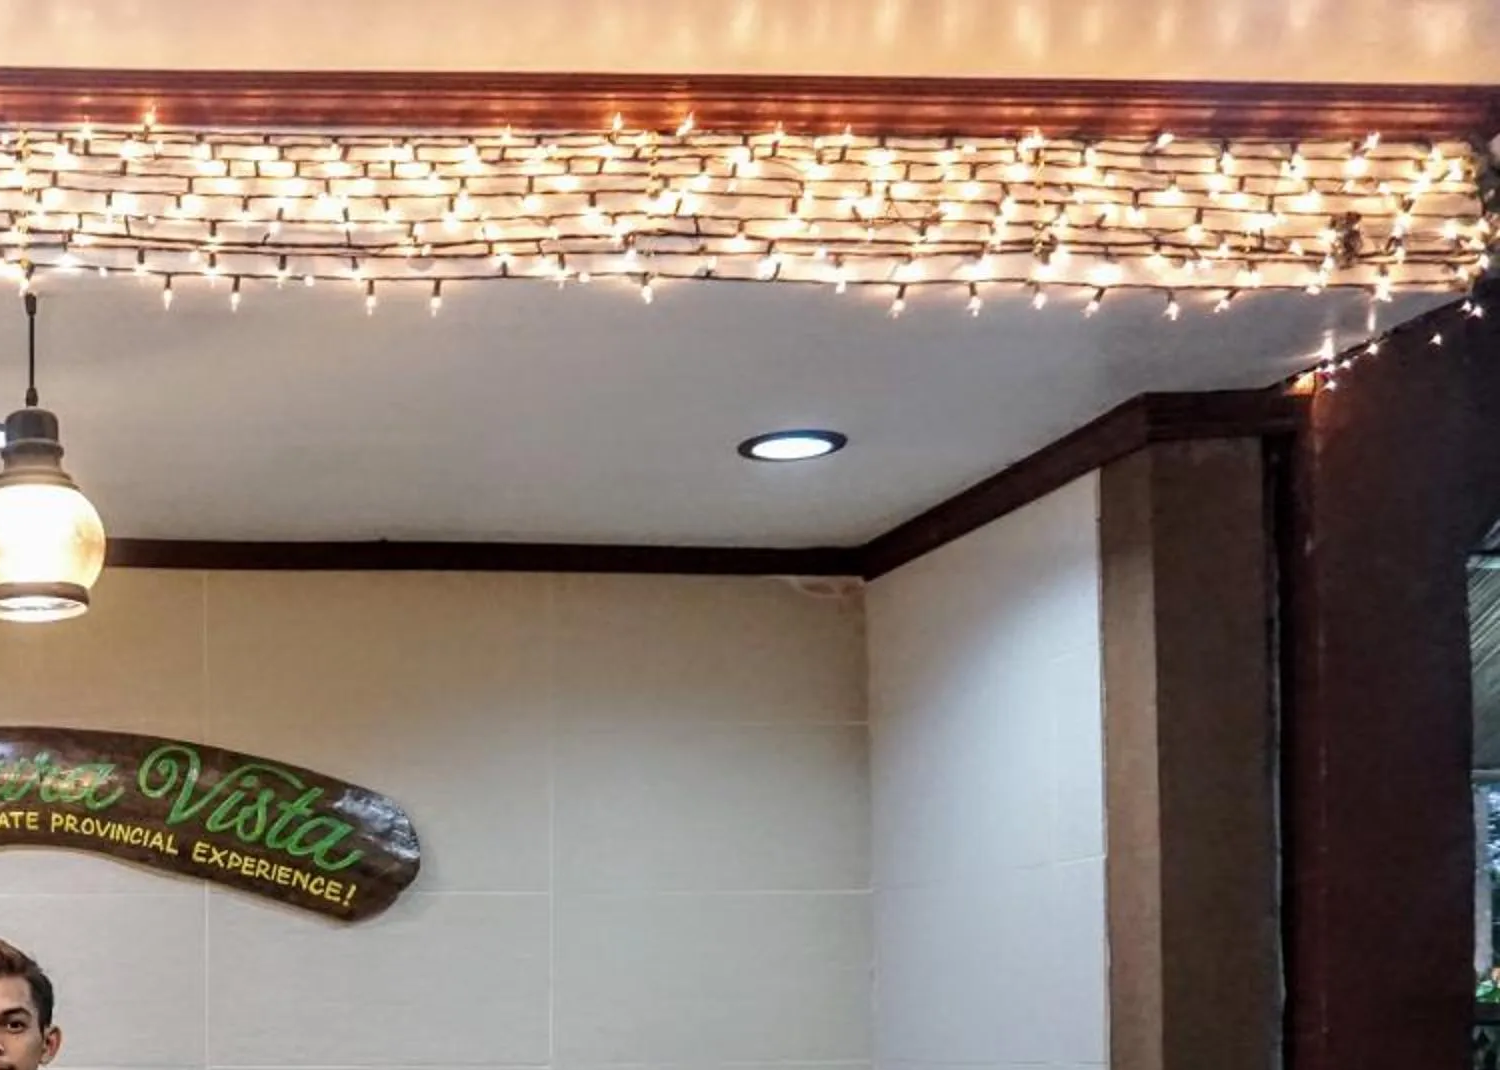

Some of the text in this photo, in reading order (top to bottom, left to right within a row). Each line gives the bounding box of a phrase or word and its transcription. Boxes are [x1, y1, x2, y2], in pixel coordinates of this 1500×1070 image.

[50, 812, 180, 856] PROVINCIAL
[191, 841, 357, 907] EXPERIENCE!
[139, 744, 364, 871] Vista
